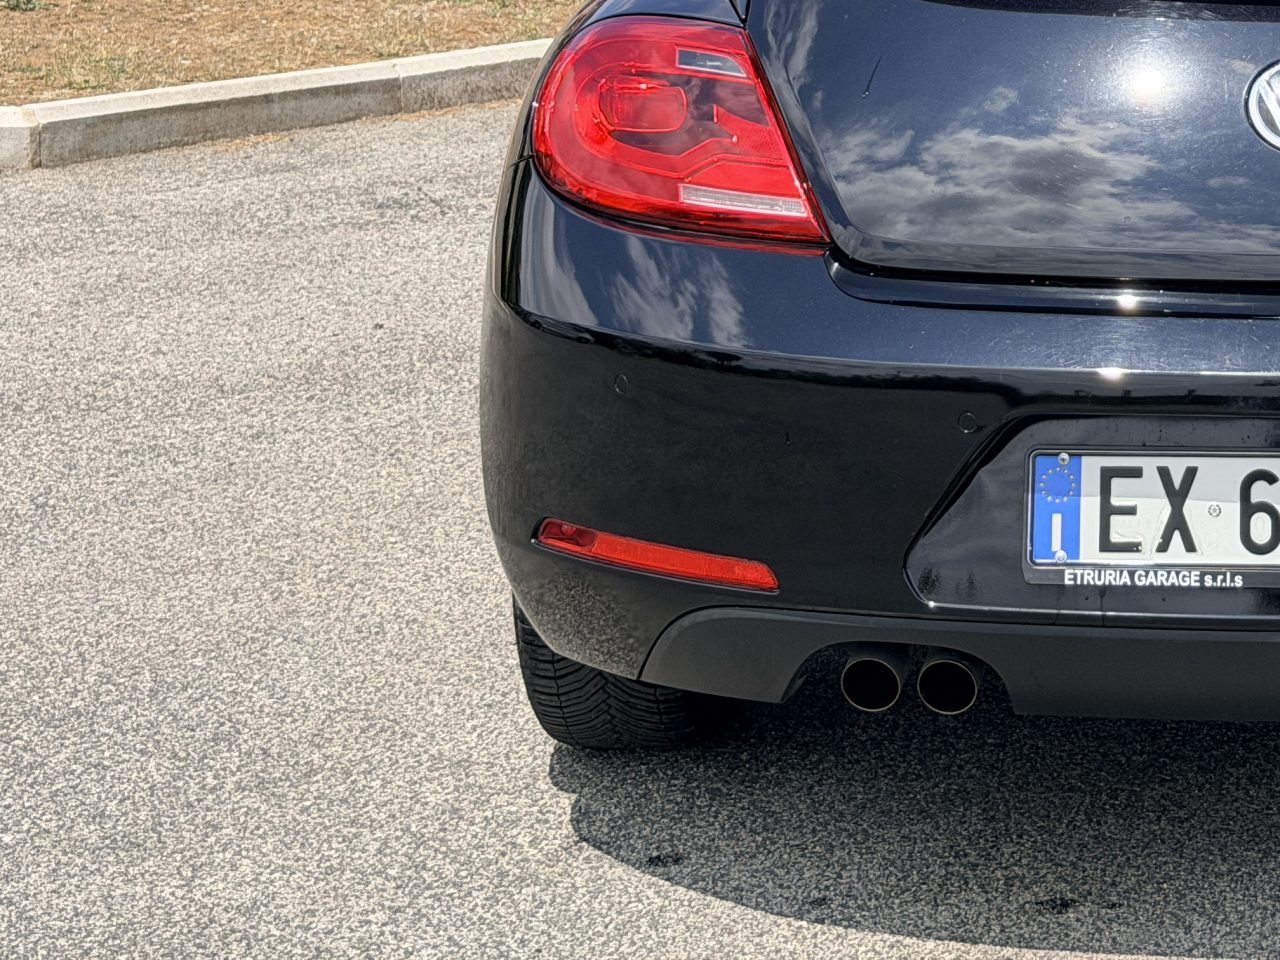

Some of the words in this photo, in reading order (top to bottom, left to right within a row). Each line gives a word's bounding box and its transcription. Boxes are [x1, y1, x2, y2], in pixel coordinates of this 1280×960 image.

[1099, 465, 1199, 553] EX
[1064, 570, 1131, 586] ETRURIA
[1134, 570, 1200, 587] GARAGE
[1204, 572, 1243, 588] s.r.l.s
